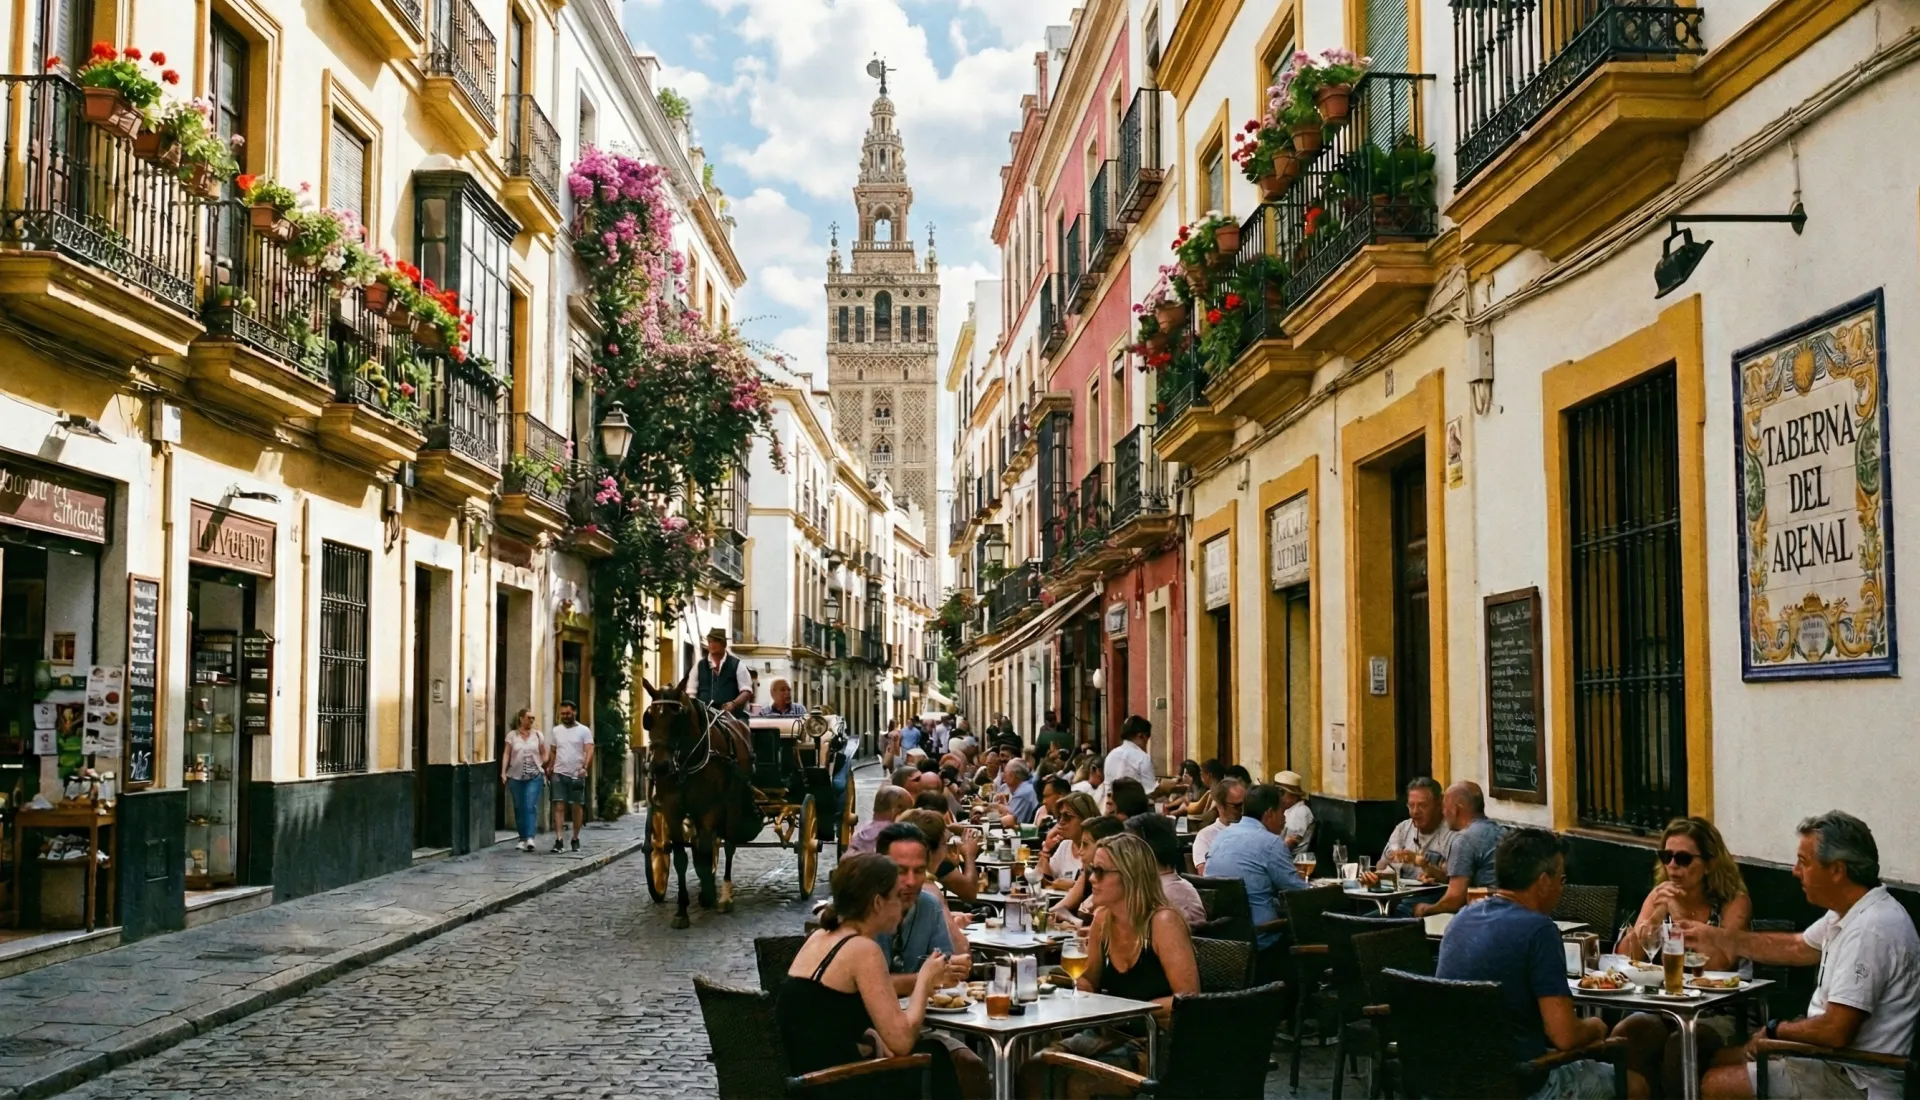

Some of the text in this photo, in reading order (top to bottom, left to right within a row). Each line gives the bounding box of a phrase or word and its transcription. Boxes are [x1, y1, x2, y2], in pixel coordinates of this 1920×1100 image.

[1763, 401, 1856, 466] TABERNA
[1789, 465, 1830, 514] DEL
[1772, 518, 1853, 575] ARENAL
